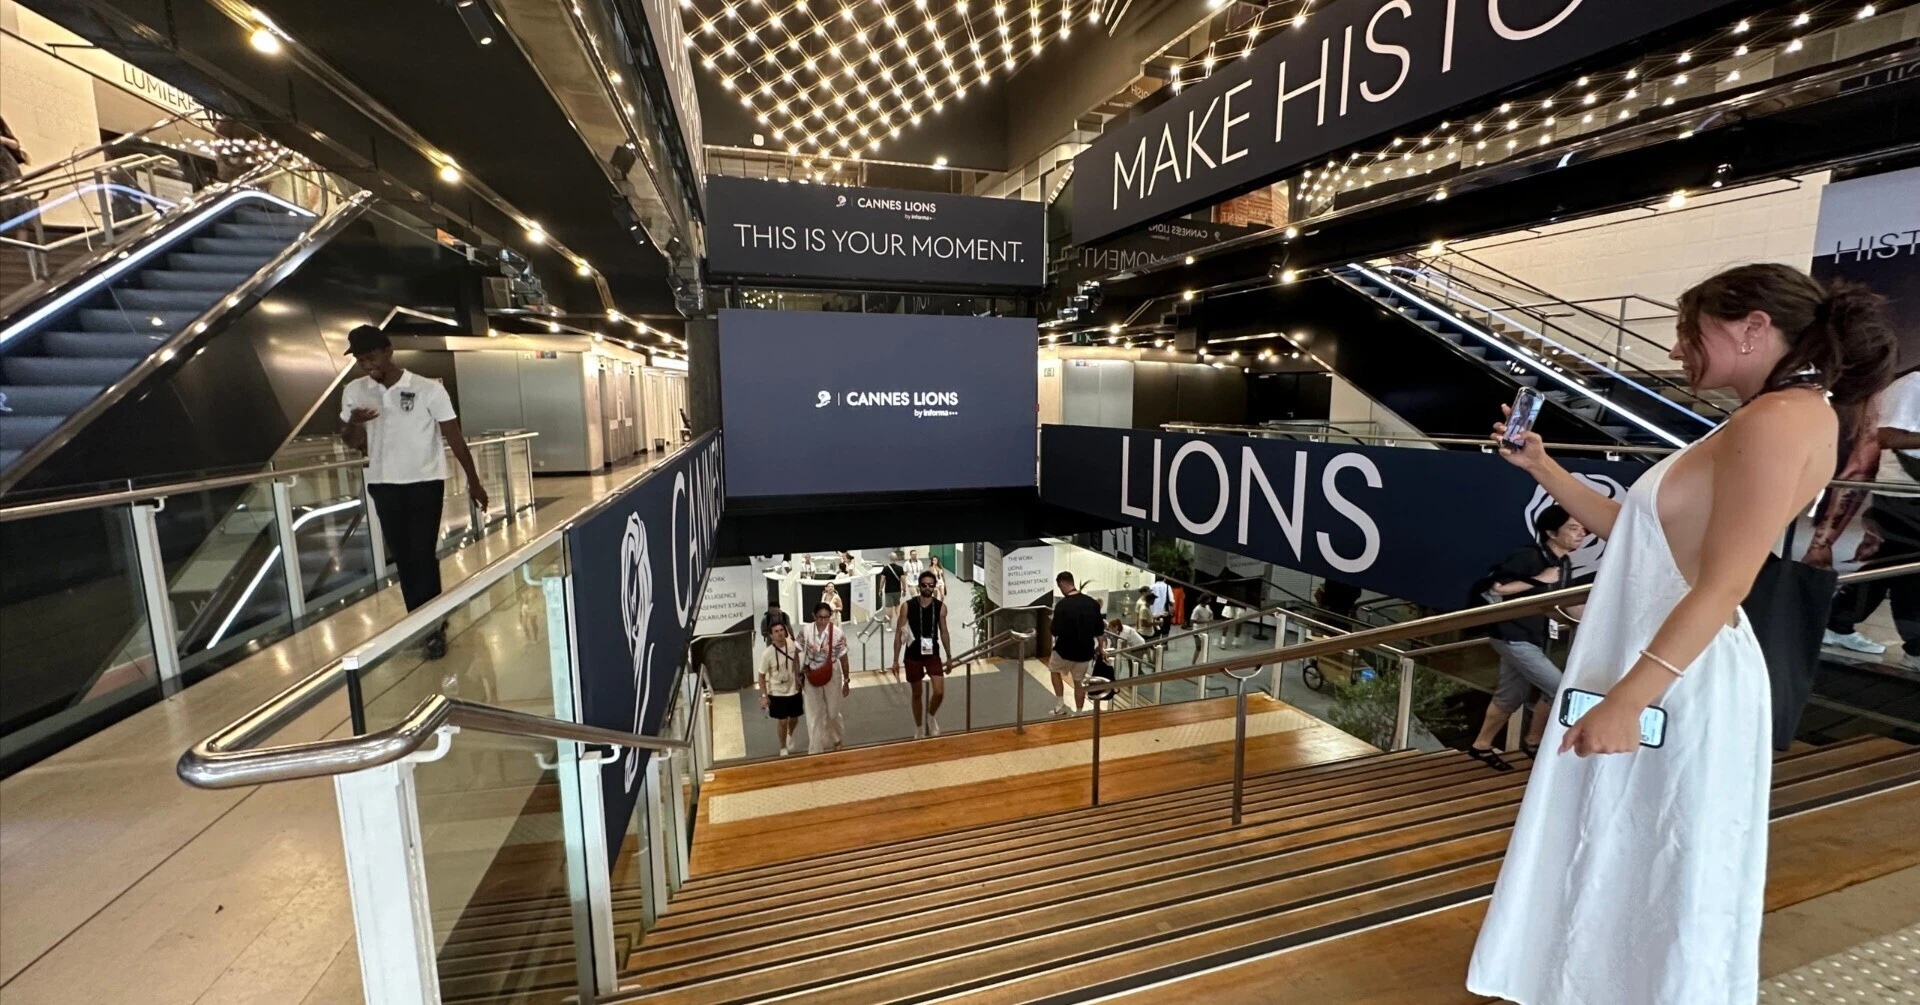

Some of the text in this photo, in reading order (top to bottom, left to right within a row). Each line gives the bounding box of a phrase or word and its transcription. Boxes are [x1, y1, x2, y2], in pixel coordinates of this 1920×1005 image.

[1112, 78, 1253, 210] MAKE
[857, 197, 937, 213] CANNES LIONS
[733, 223, 1025, 263] THIS IS YOUR MOMENT.
[1834, 229, 1920, 264] HIST
[846, 391, 959, 406] CANNES LIONS
[913, 409, 923, 418] by
[1121, 435, 1384, 573] LIONS
[671, 436, 720, 629] CANNES
[700, 603, 727, 611] SEMENT
[704, 592, 737, 600] ELLIGENCE
